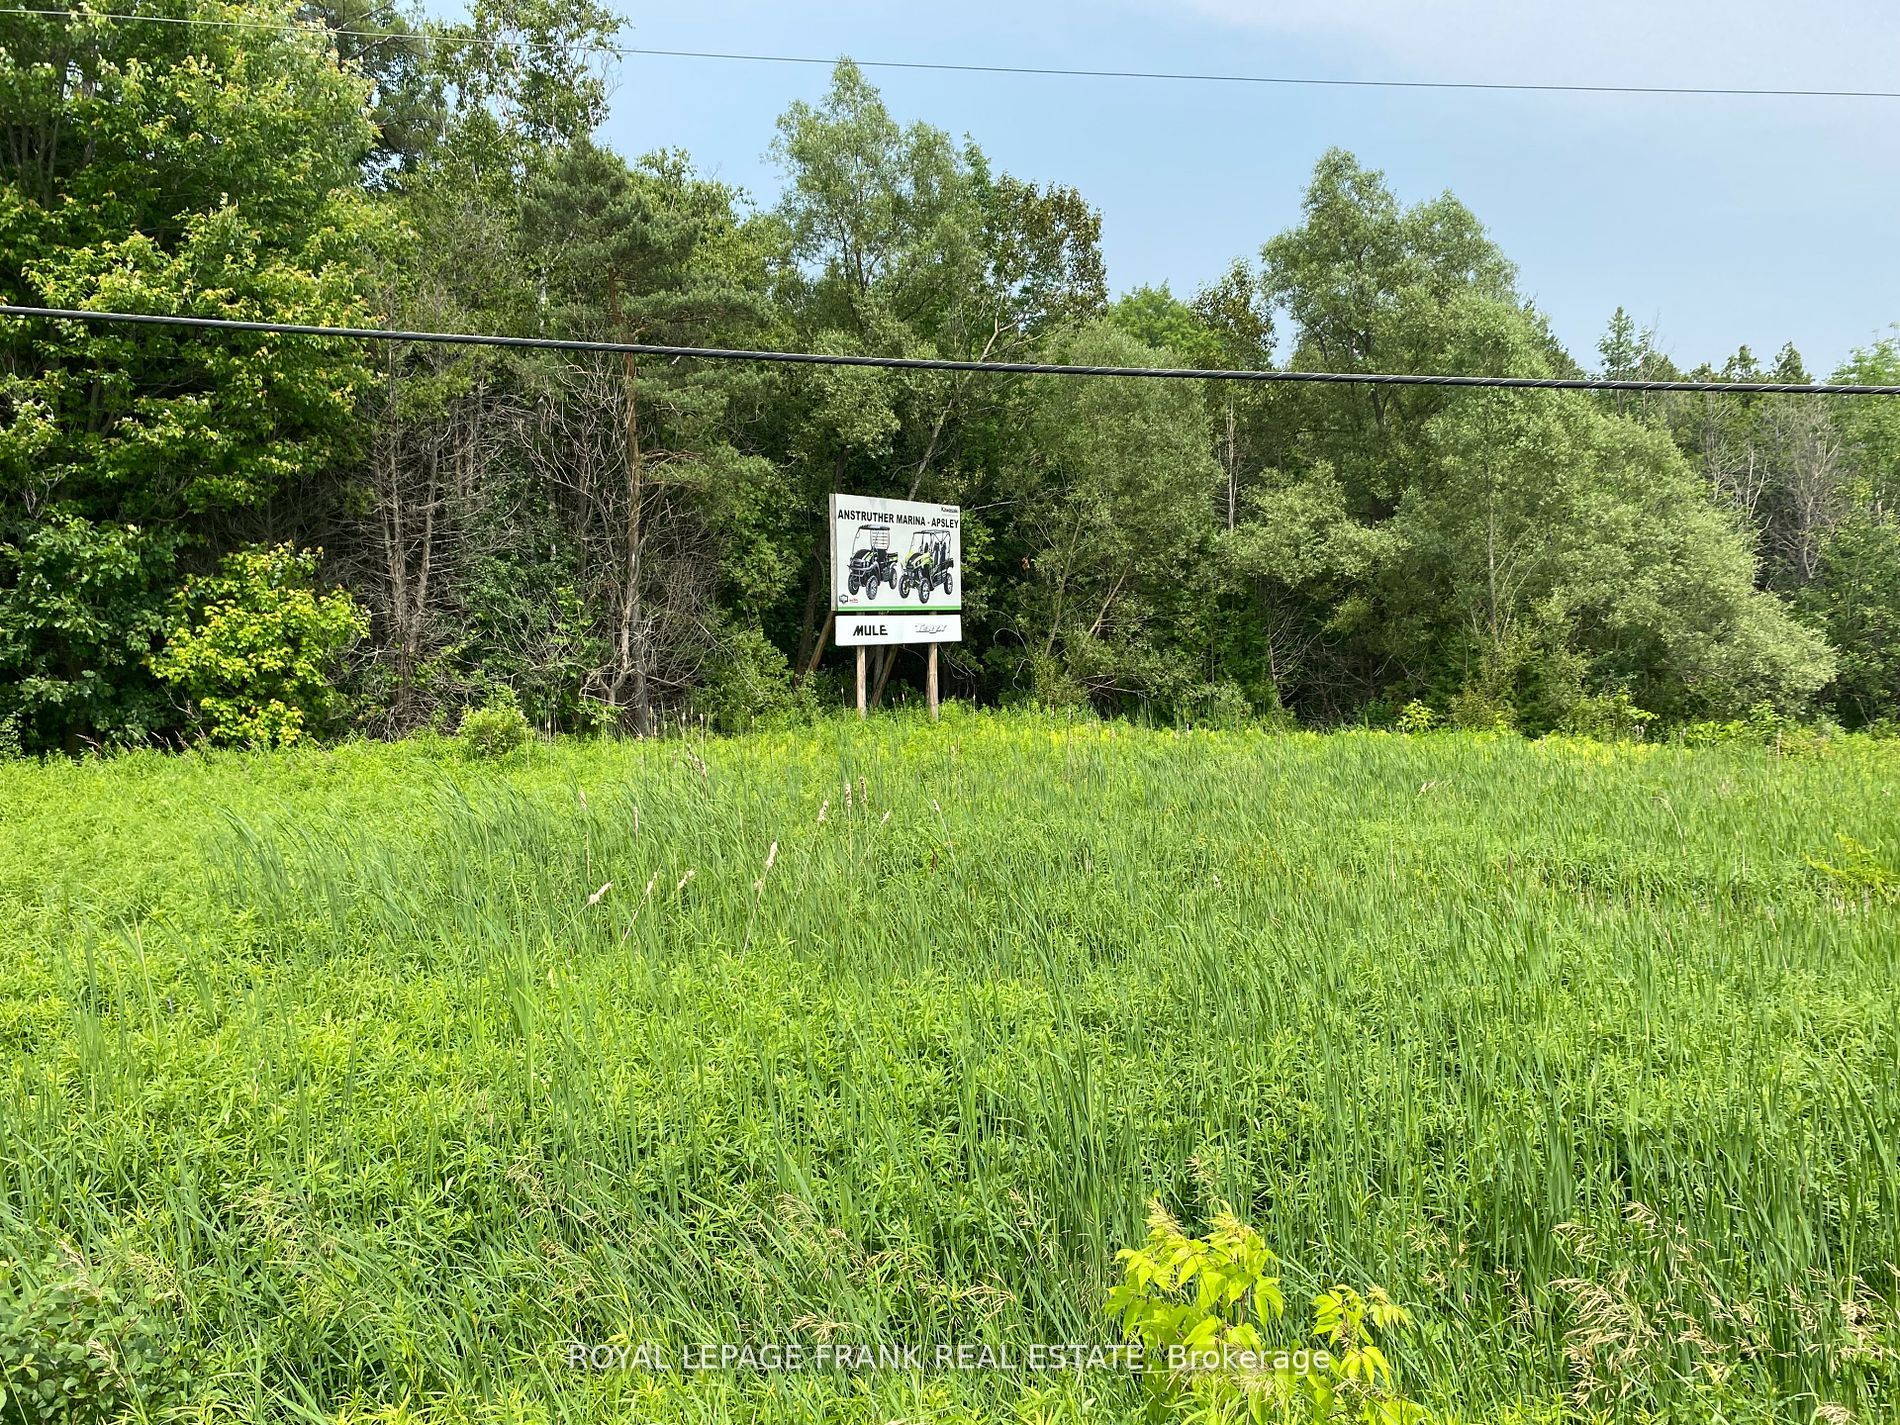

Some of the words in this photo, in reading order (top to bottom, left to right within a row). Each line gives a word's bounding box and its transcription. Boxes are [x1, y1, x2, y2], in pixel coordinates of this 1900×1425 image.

[838, 509, 894, 523] ANSTRUTHER
[896, 514, 925, 526] MARINA
[931, 518, 958, 528] APSLEY
[853, 625, 888, 636] MULE
